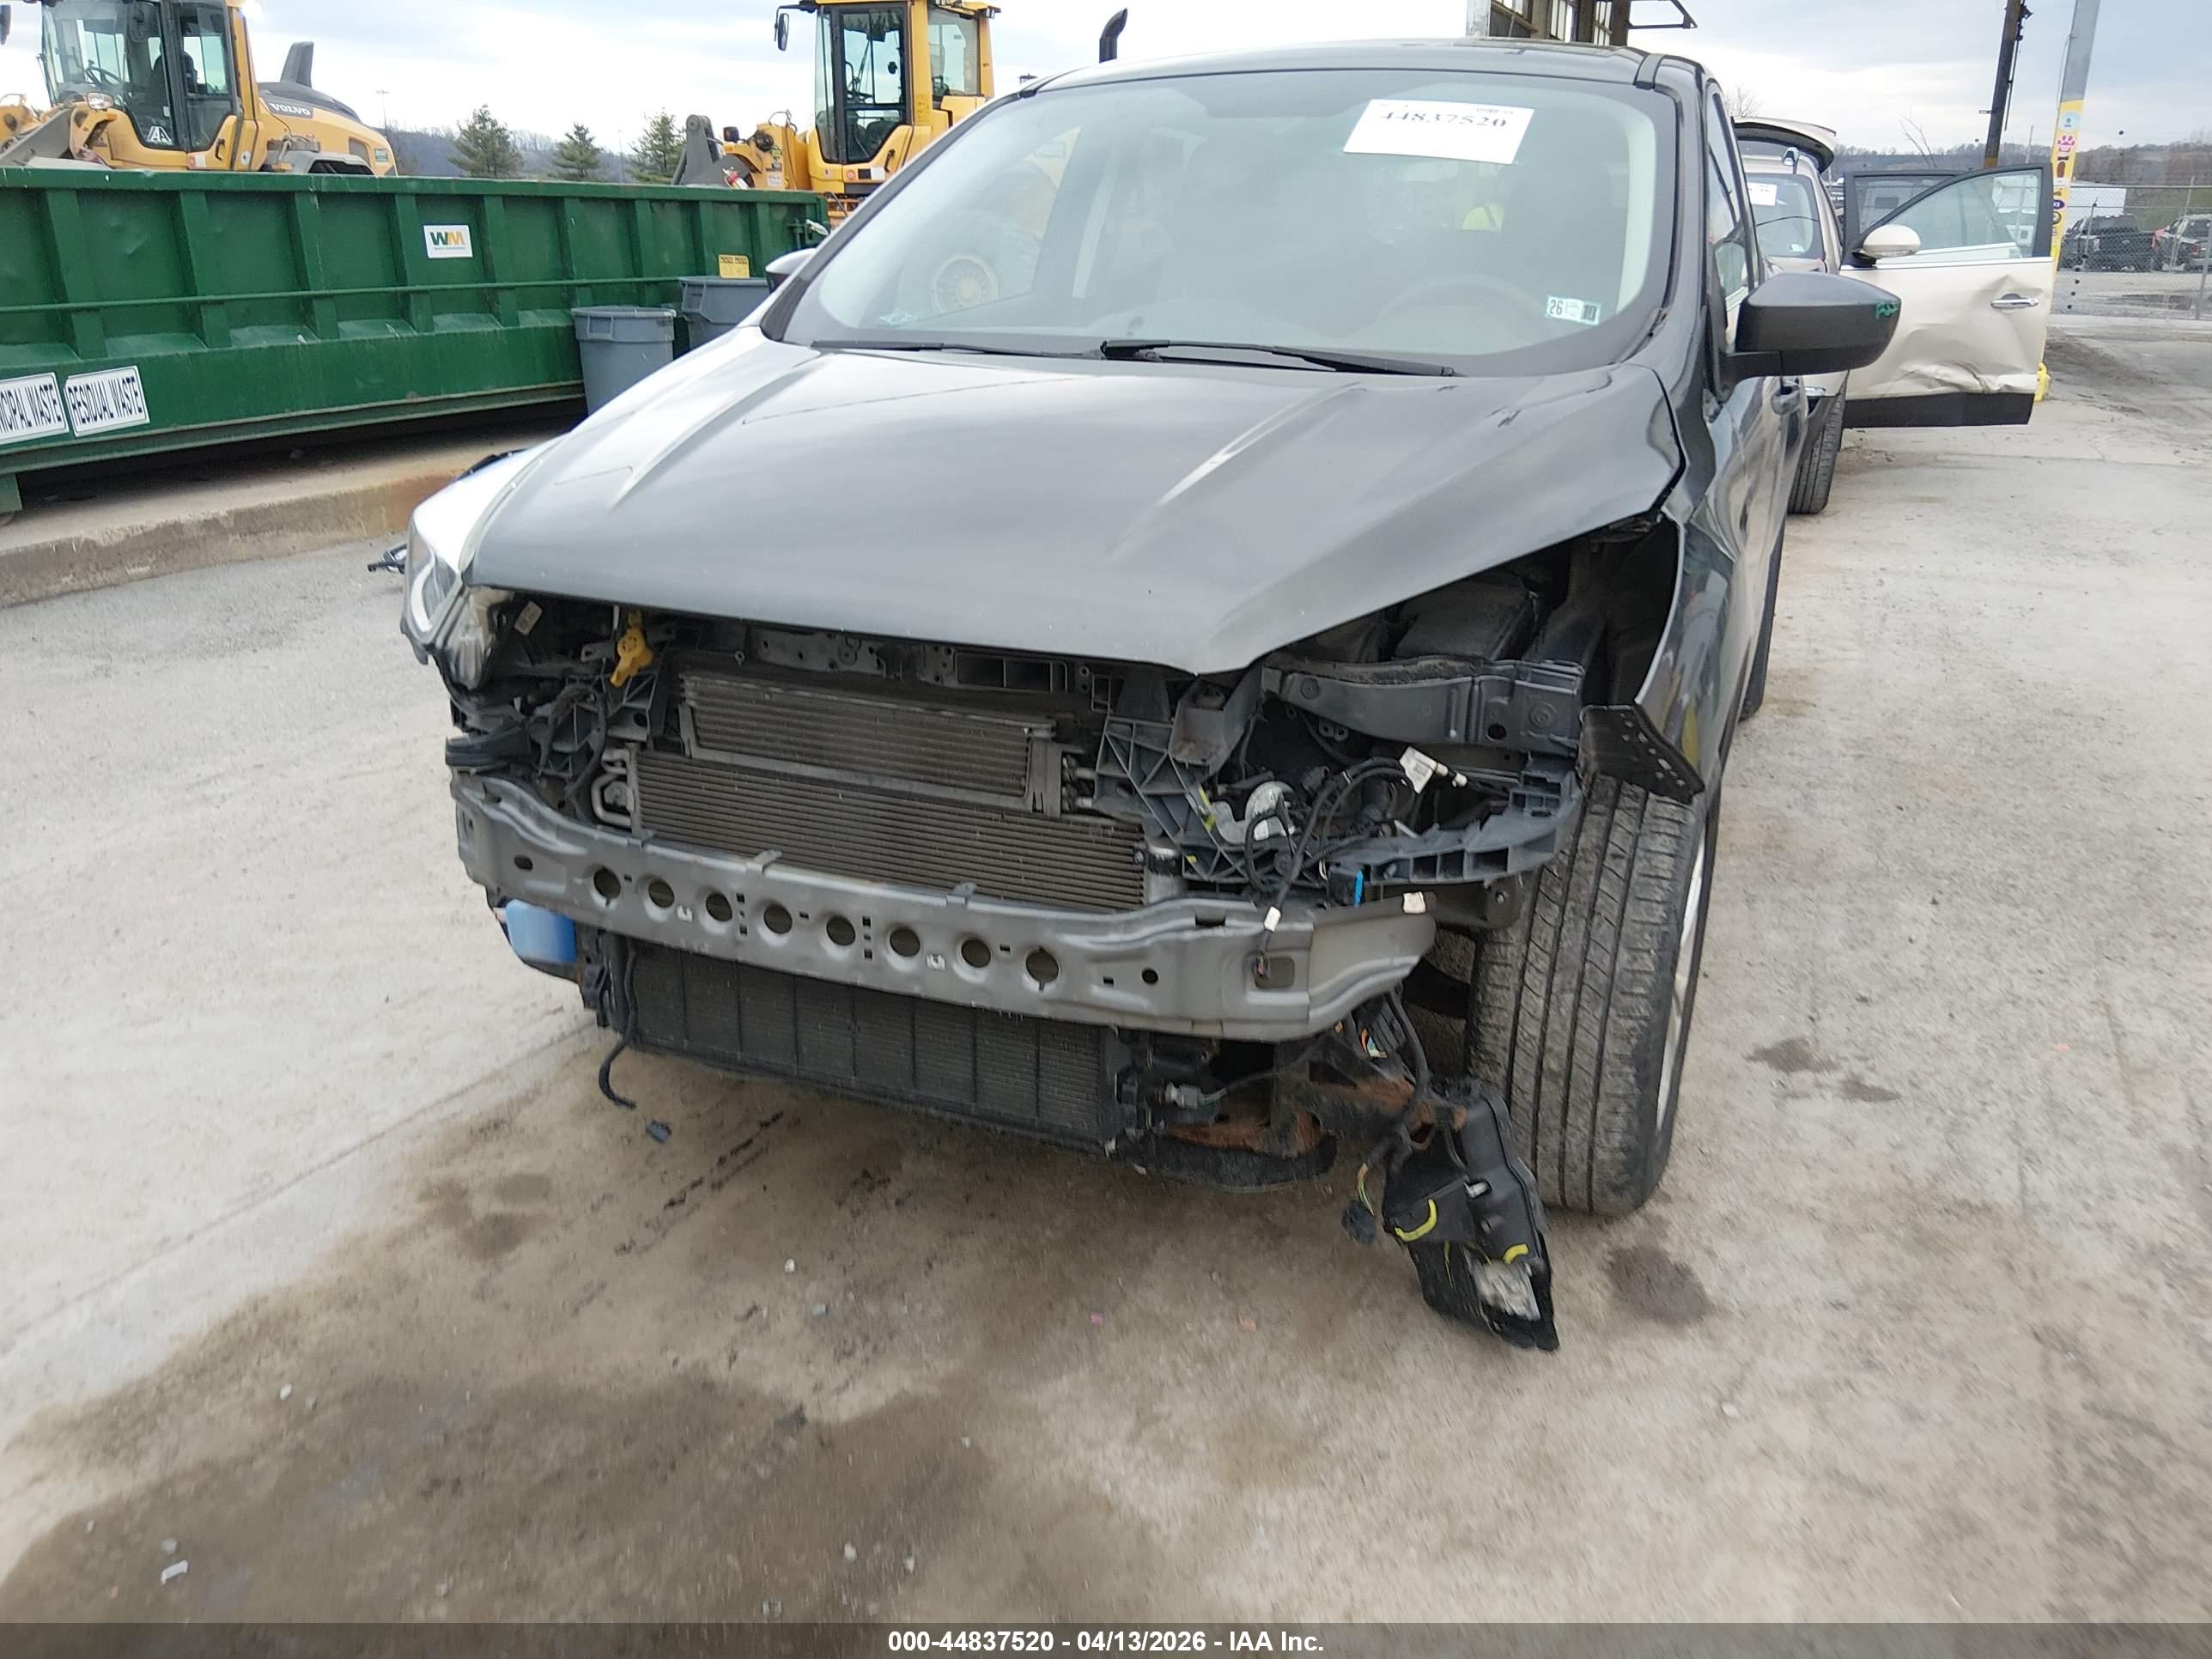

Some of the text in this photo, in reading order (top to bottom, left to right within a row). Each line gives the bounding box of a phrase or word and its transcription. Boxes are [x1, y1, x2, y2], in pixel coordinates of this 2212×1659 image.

[269, 102, 311, 115] VOLVO
[429, 231, 465, 246] WM
[1549, 299, 1564, 315] 26
[1583, 305, 1597, 321] 10
[25, 383, 62, 427] WASTE
[68, 376, 143, 426] RESIDUAL WASTE
